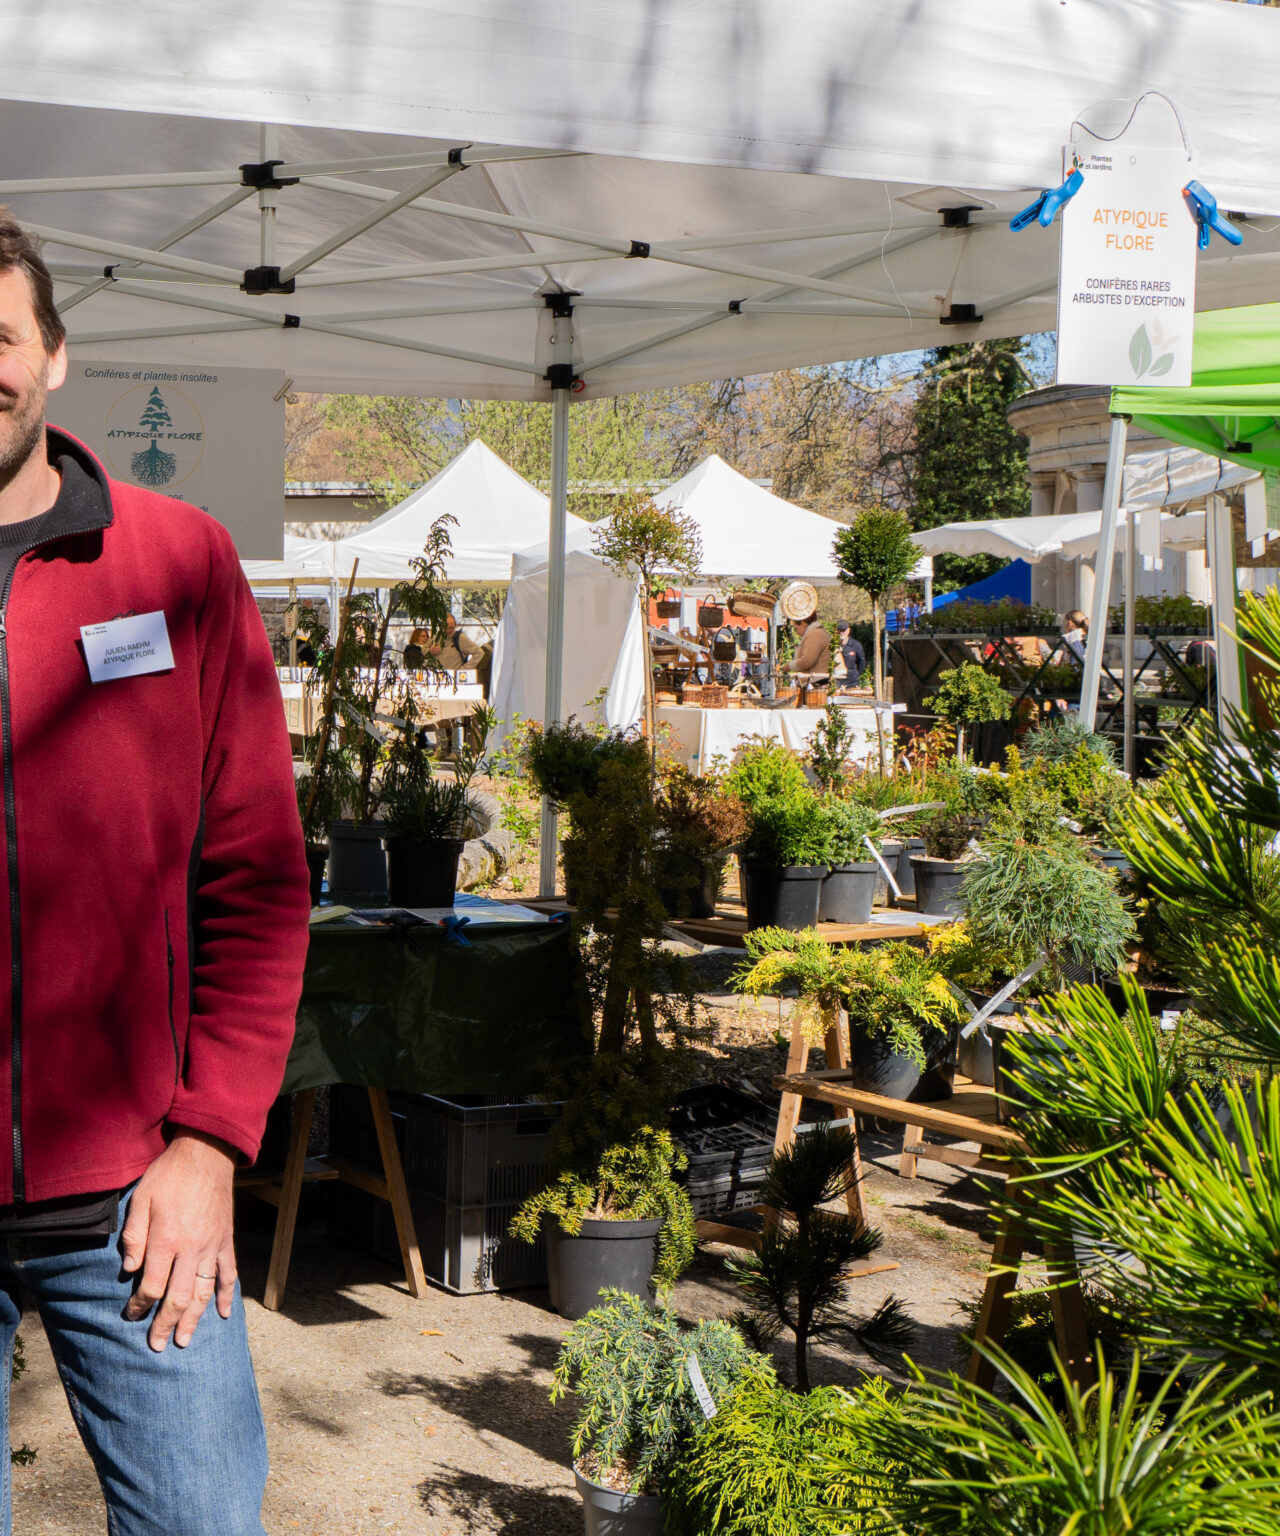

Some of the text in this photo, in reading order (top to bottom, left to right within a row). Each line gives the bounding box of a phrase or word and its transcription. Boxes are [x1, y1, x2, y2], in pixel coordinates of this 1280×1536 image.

[1093, 209, 1168, 229] ATYPIQUE
[1106, 234, 1154, 251] FLORE
[1086, 277, 1171, 292] CONIFÈRES RARES
[1072, 293, 1185, 307] ARBUSTES D'EXCEPTION
[132, 370, 141, 379] et
[144, 370, 177, 381] plantes
[180, 372, 218, 383] insolites
[107, 430, 202, 440] ATYPIQUE FLORE
[104, 645, 126, 656] JULIEN
[104, 648, 156, 665] ATYPIQUE FLORE
